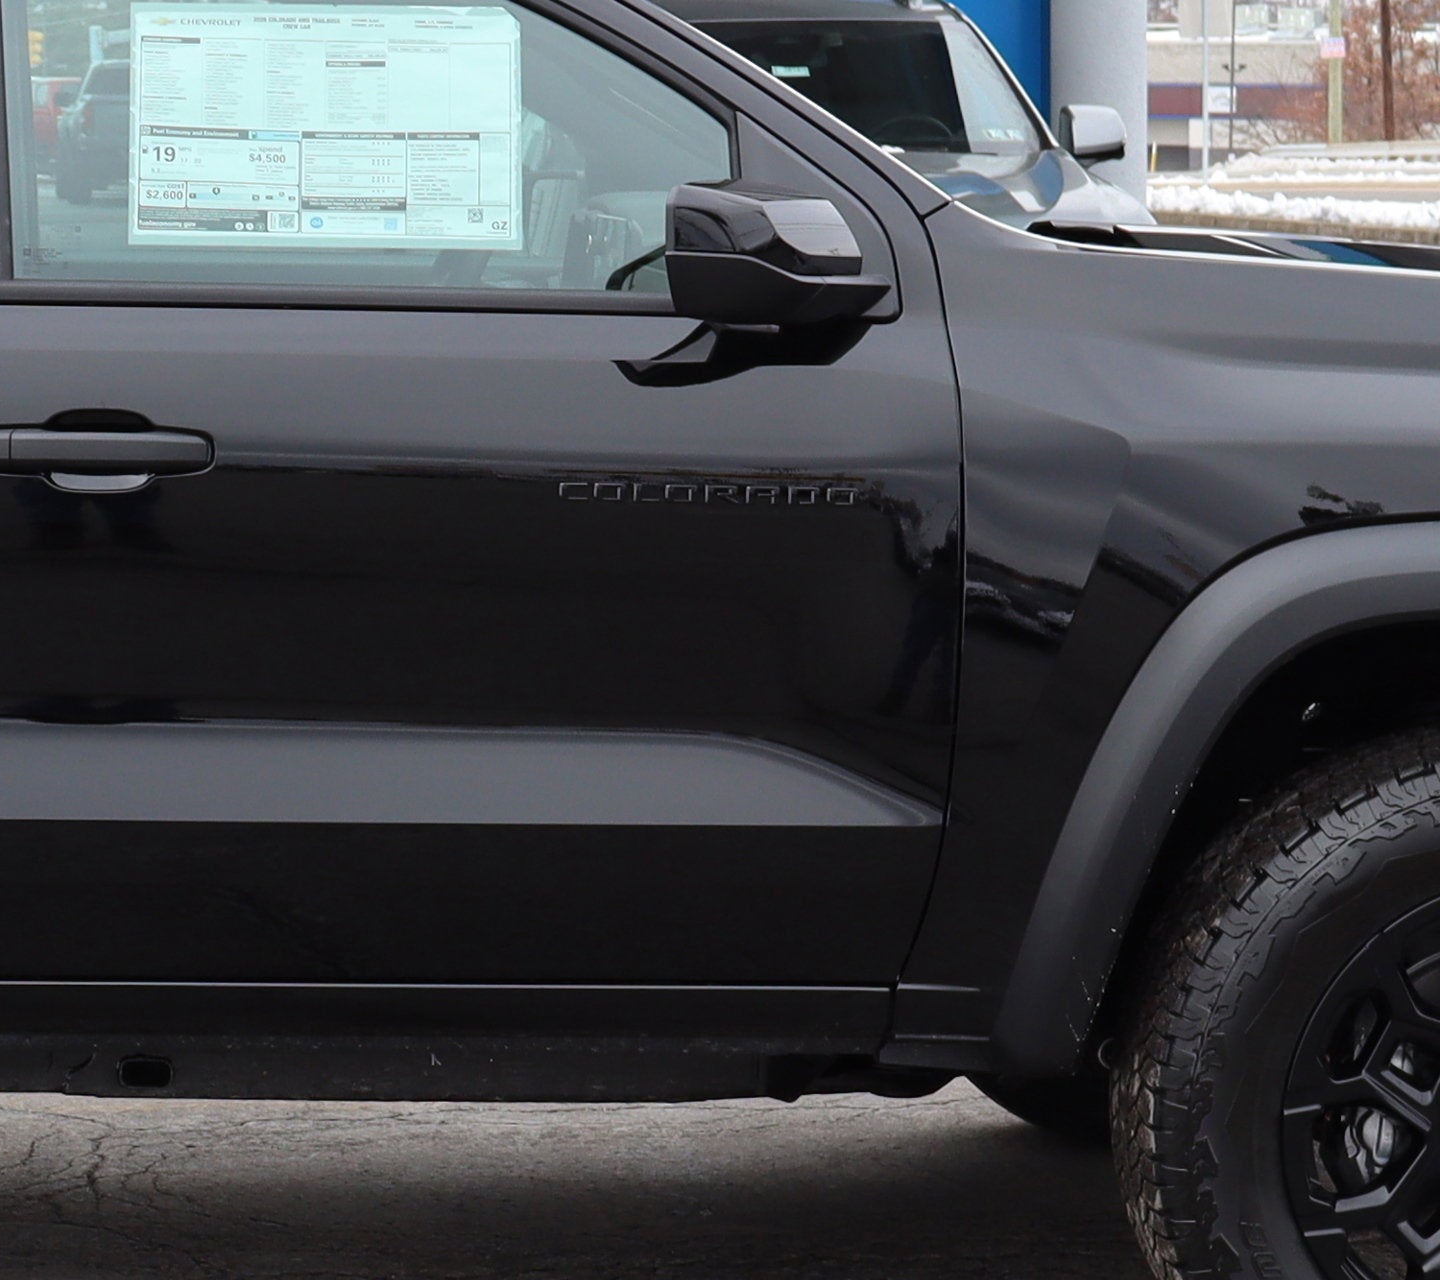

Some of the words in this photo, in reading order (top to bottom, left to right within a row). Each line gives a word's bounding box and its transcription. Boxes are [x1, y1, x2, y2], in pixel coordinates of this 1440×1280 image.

[180, 18, 242, 27] CHEVROLET
[152, 145, 176, 163] 19
[248, 152, 287, 164] $4,500
[146, 189, 184, 200] $2,600
[491, 220, 508, 231] GZ
[559, 482, 859, 506] COLORADO
